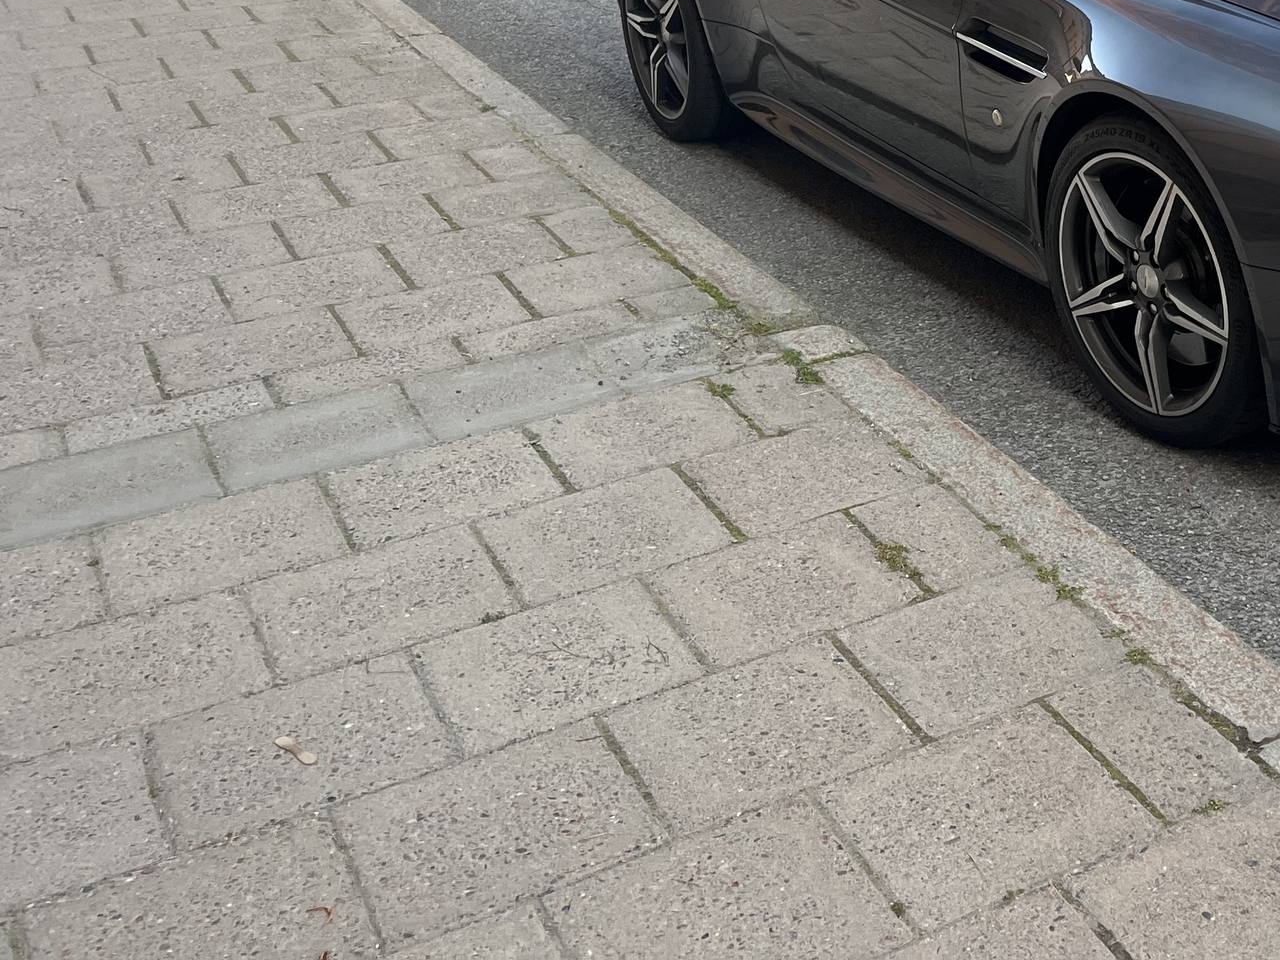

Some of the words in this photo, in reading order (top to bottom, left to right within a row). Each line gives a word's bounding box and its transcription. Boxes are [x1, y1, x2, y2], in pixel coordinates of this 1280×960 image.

[1084, 127, 1117, 142] 245/40
[1118, 127, 1132, 139] ZR
[1134, 132, 1146, 143] 19
